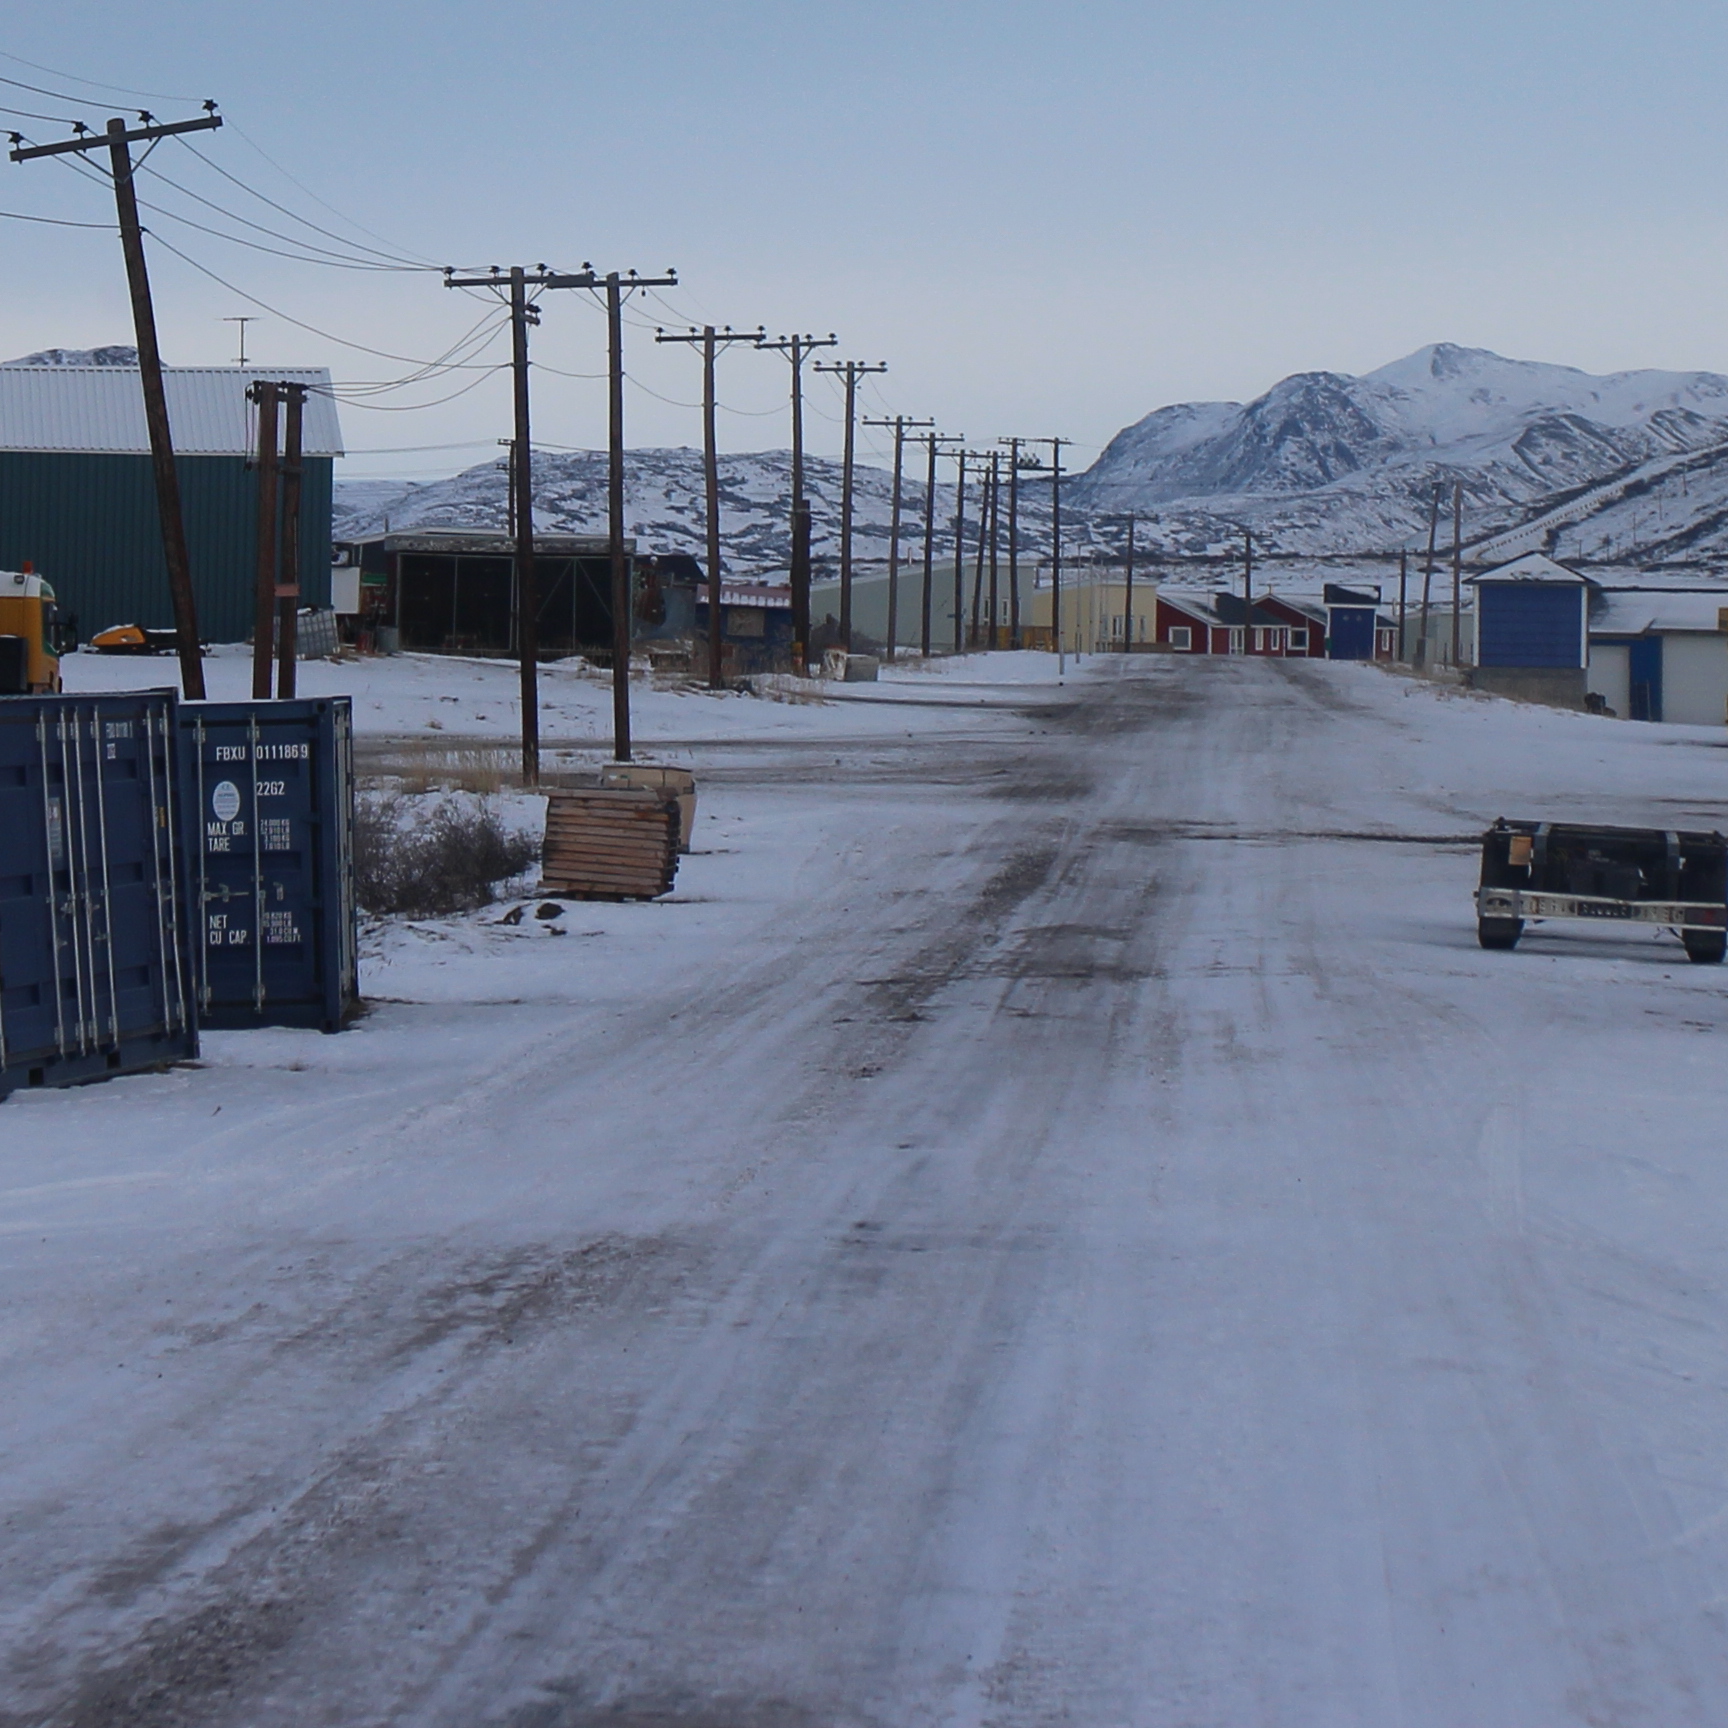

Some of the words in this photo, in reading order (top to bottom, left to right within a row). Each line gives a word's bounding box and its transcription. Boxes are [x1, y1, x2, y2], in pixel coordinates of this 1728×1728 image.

[216, 746, 246, 761] FBXU
[256, 781, 285, 796] 22G2
[208, 837, 230, 852] TARE
[209, 914, 228, 929] NET
